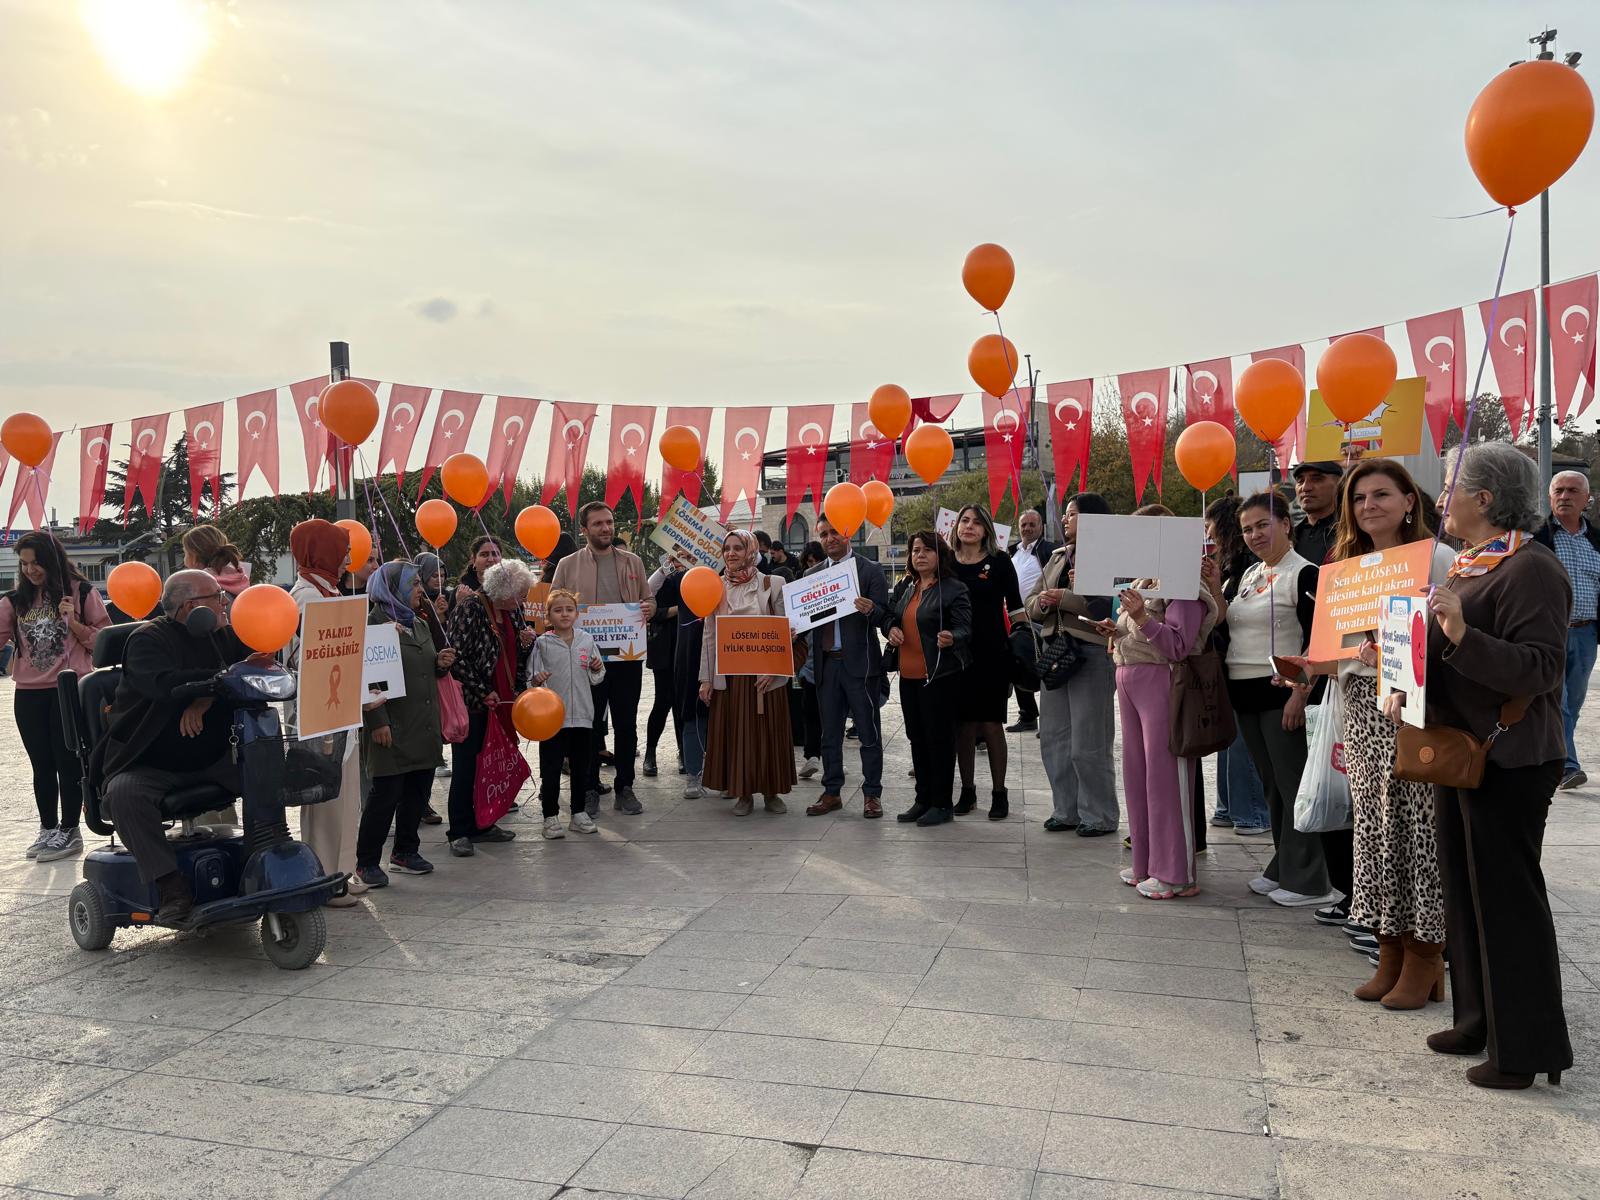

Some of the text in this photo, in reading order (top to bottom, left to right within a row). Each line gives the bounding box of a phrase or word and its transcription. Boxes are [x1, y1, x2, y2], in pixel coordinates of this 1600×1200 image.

[675, 508, 716, 541] LÖSEMA İLE
[669, 517, 722, 559] RUHUM GÜÇLÜ
[662, 524, 719, 569] BEDENİM GÜÇLÜ
[1334, 562, 1409, 588] Sen de LÖSEMA
[801, 583, 841, 604] GÜÇLÜ OL
[1326, 578, 1414, 604] ailesine katıl akran
[803, 600, 823, 611] Kanser
[799, 609, 816, 619] Hayat
[583, 618, 624, 626] HAYATIN
[1336, 617, 1365, 631] hayata
[318, 626, 353, 641] YALNIZ
[581, 625, 634, 634] NKLERİYLE
[609, 632, 638, 640] YEN...!
[731, 630, 779, 640] LÖSEMİ DEĞİL
[1382, 627, 1394, 642] Hayat
[306, 641, 360, 660] DEĞİLSİNİZ
[723, 644, 745, 653] İYİLİK
[1382, 642, 1395, 655] Kanser
